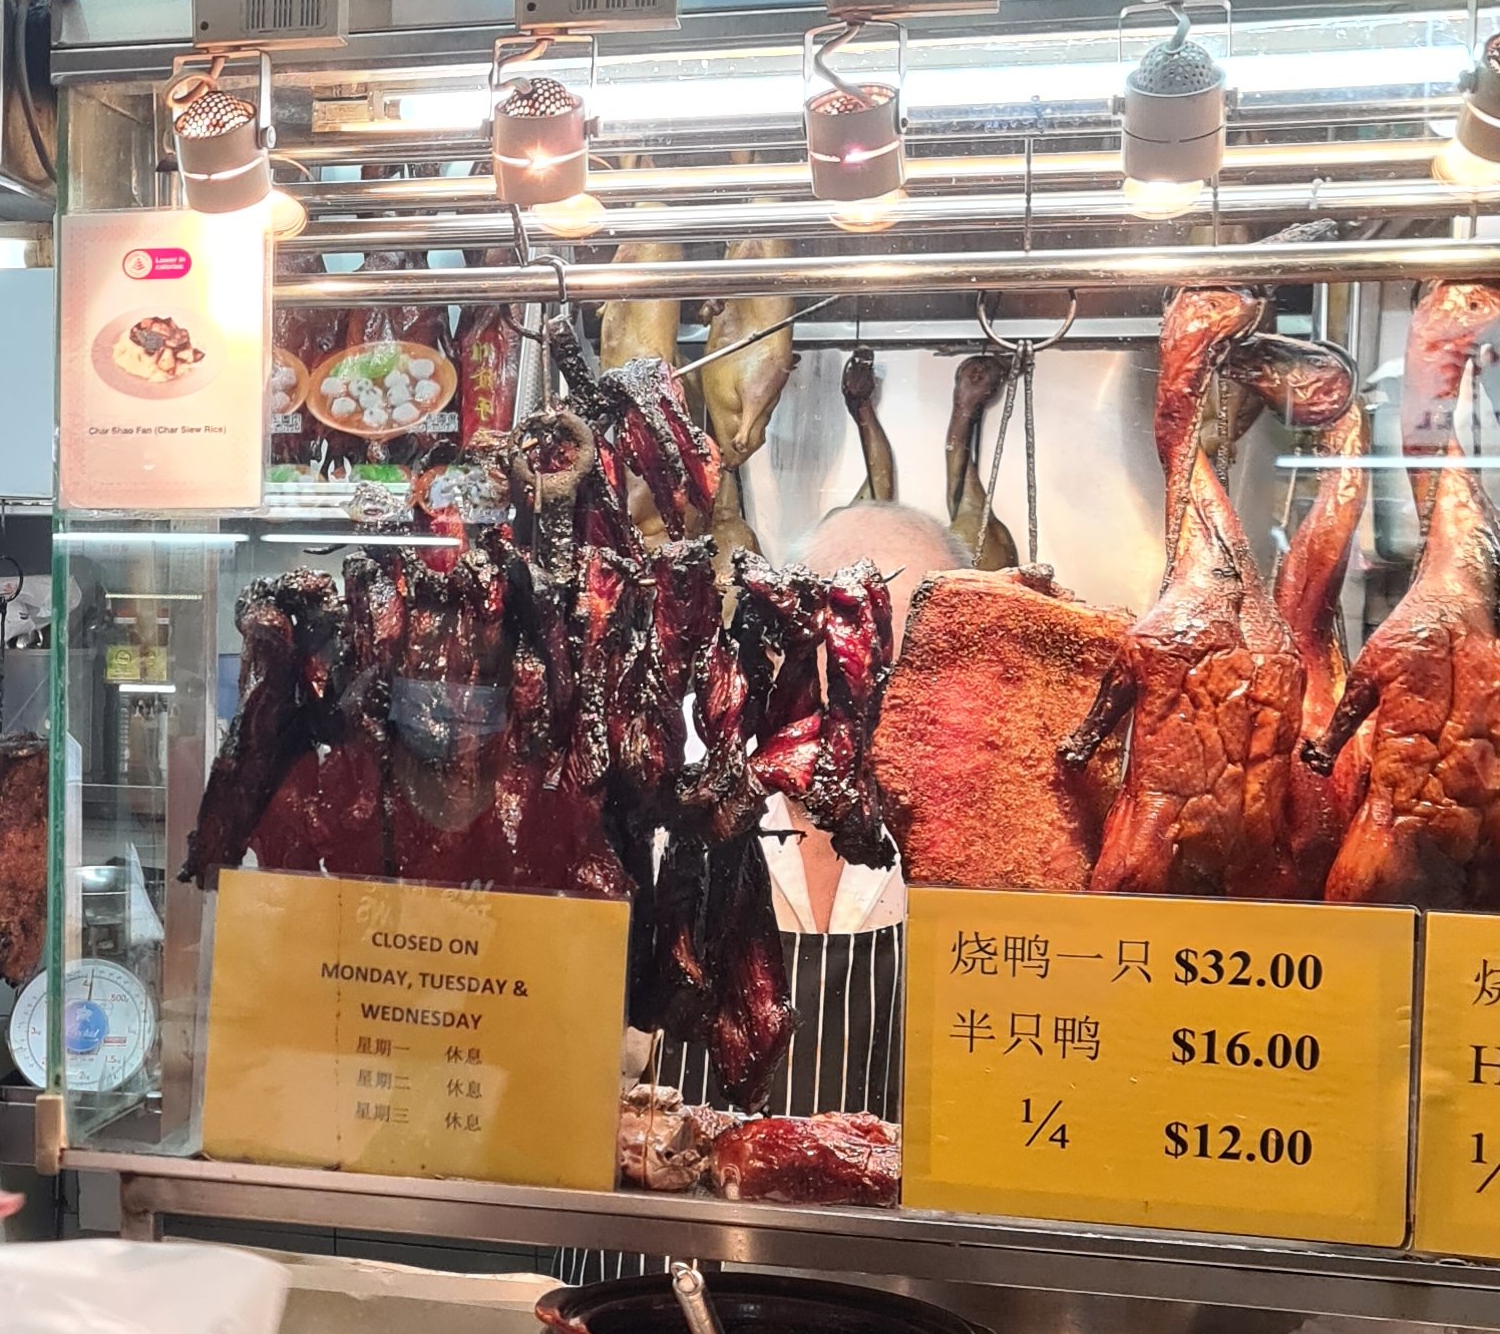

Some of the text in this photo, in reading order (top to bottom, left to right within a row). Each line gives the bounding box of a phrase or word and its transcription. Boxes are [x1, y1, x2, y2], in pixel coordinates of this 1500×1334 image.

[88, 425, 226, 436] Char Shao Fan (Char Siew Rice)
[372, 931, 479, 956] CLOSED ON
[950, 930, 1323, 991] 烧鸭一只 $32.00
[321, 962, 528, 997] MONDAY, TUESDAY &
[361, 1003, 483, 1030] WEDNESDAY
[356, 1035, 483, 1066] 星期一 休息
[949, 1008, 1320, 1071] 半只鸭 $16.00
[356, 1069, 483, 1099] 星期二 休息
[355, 1101, 482, 1132] 星期三 休息
[1163, 1121, 1312, 1166] $12.00
